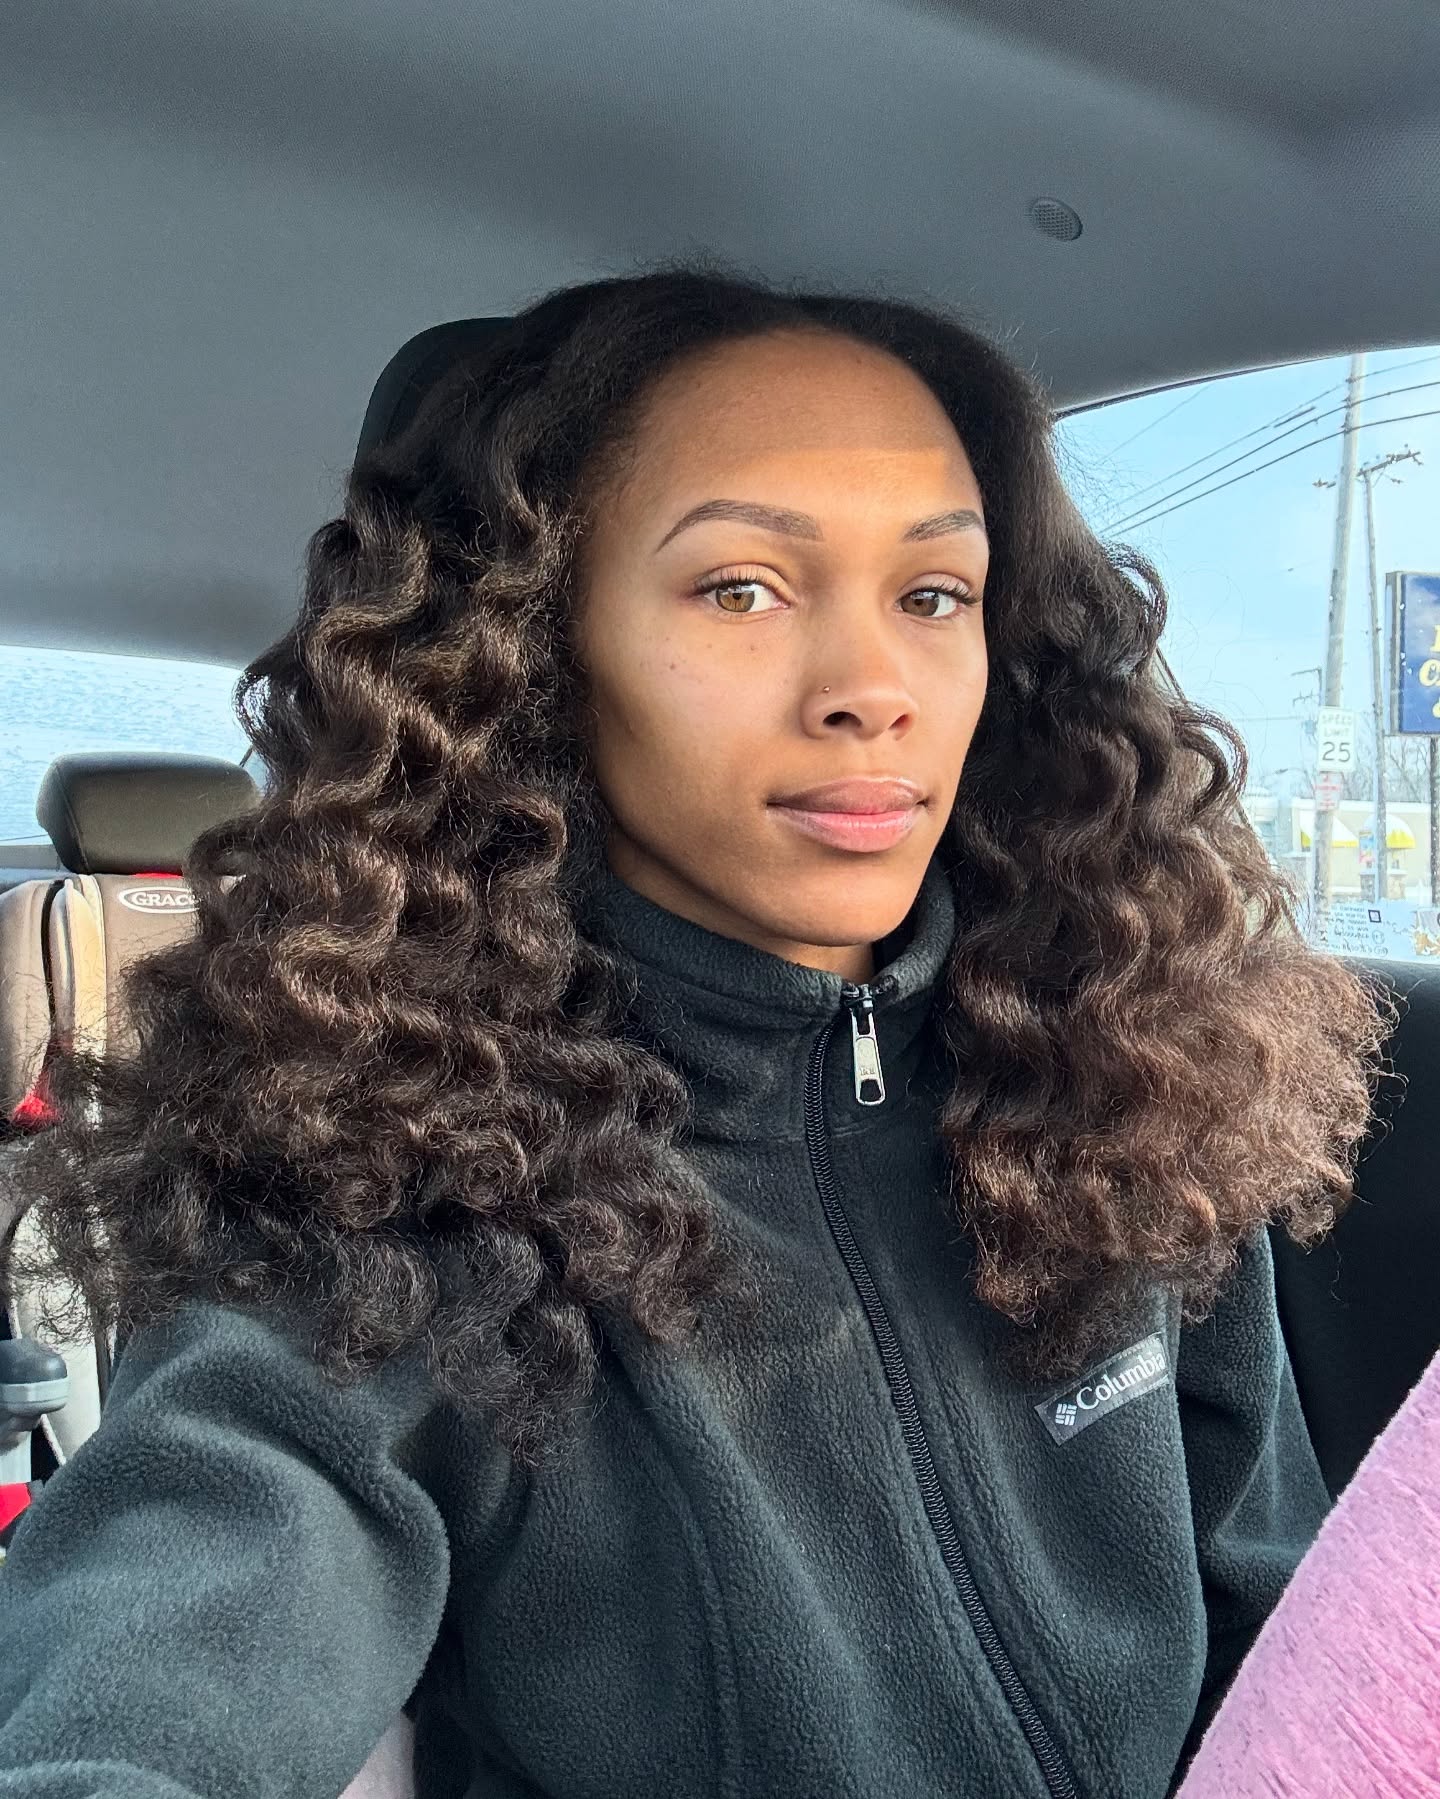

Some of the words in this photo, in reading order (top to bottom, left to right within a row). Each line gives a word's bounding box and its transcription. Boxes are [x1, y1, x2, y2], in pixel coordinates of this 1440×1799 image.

[1321, 713, 1353, 726] SPEED
[1323, 727, 1350, 738] LIMIT
[1321, 741, 1352, 764] 25
[1075, 1351, 1167, 1410] Columbia
